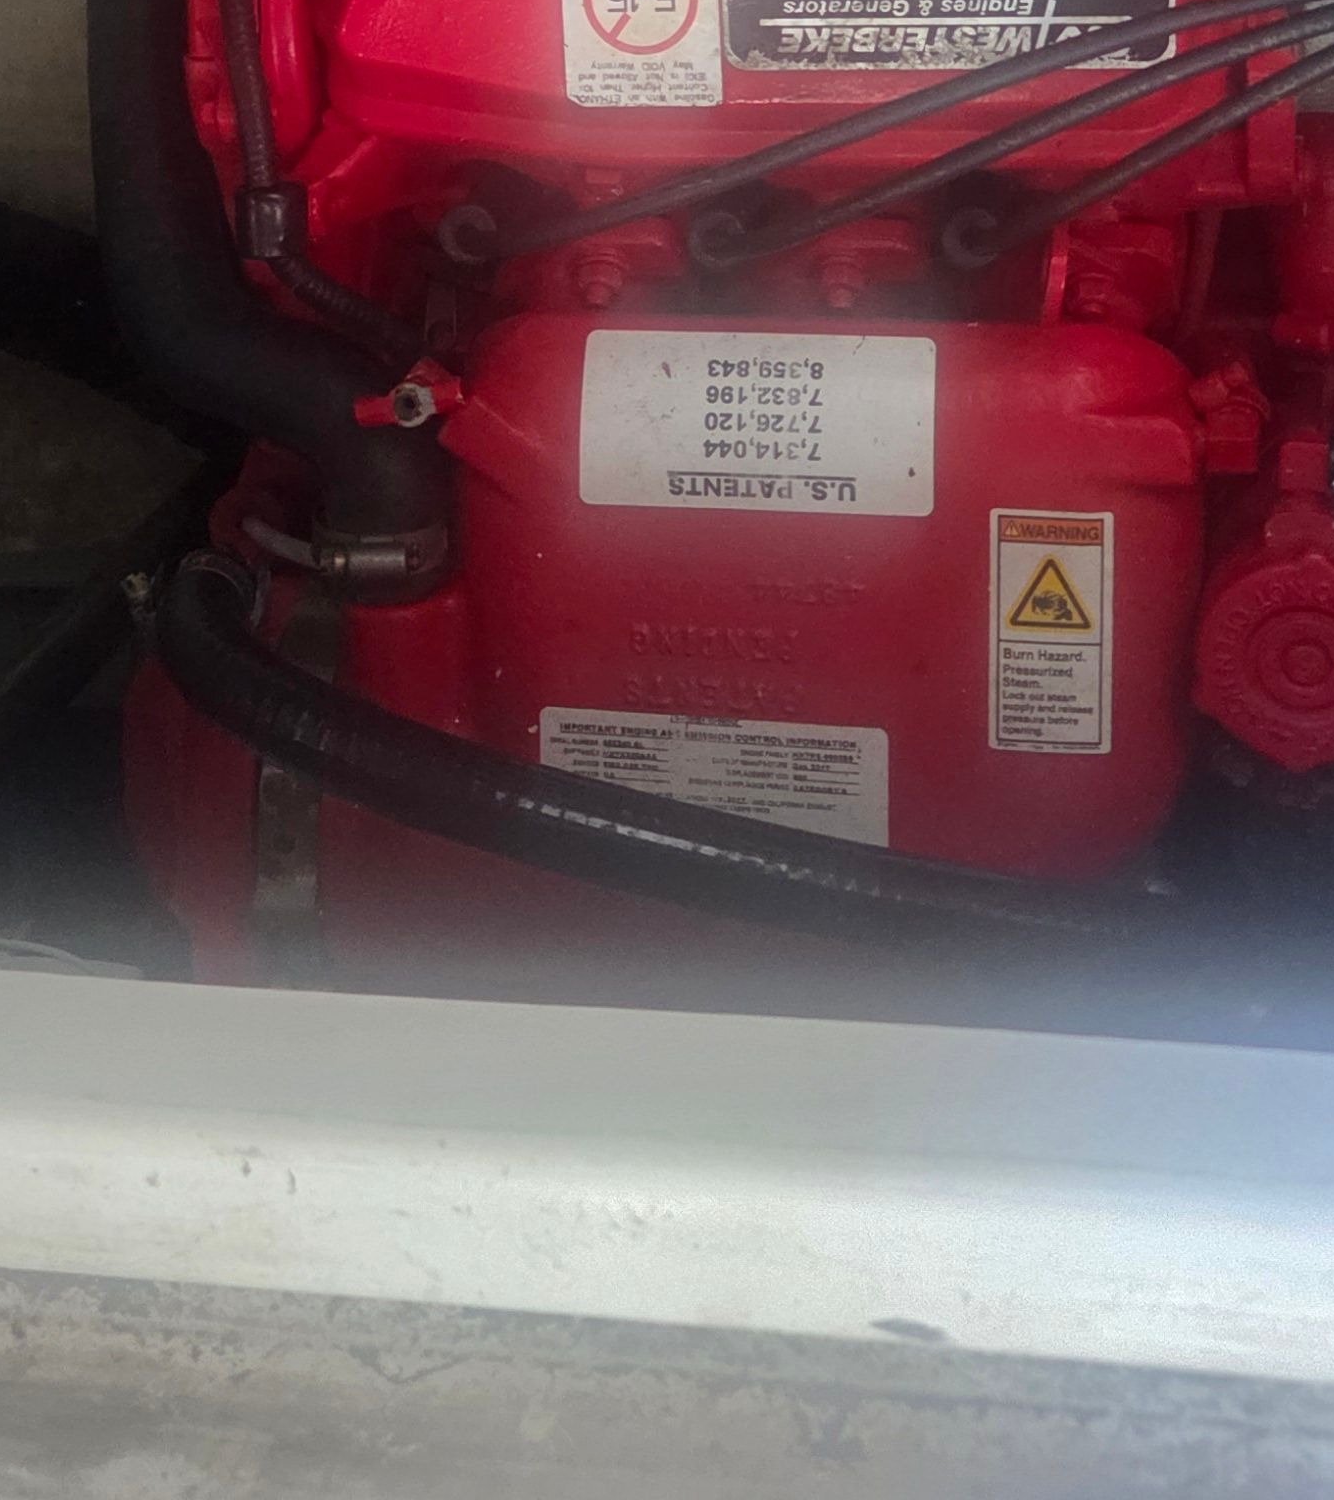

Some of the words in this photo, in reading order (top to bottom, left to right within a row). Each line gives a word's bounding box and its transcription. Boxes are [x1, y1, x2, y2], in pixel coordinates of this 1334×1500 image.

[783, 0, 910, 16] Generators
[918, 0, 933, 14] &
[778, 26, 1033, 53] WESTERBEKE
[591, 61, 634, 70] Warranty
[642, 62, 665, 70] VOID
[673, 61, 693, 69] May
[600, 84, 622, 92] Than
[632, 83, 661, 91] Higher
[707, 357, 824, 379] 8,359,843
[706, 383, 823, 406] 7,832,196
[704, 410, 822, 433] 7,726,120
[703, 439, 821, 461] 7,314,044
[667, 476, 793, 500] PATENTS
[803, 480, 857, 502] U.S.
[1019, 525, 1100, 541] WARNING
[1003, 648, 1034, 660] Burn
[1038, 650, 1087, 663] Hazard.
[1003, 664, 1073, 678] Pressurized
[1003, 677, 1043, 689] Steam.
[1002, 691, 1026, 700] Lock
[1038, 704, 1055, 713] and
[734, 733, 784, 746] CONTROL
[785, 737, 857, 749] INFORMATION
